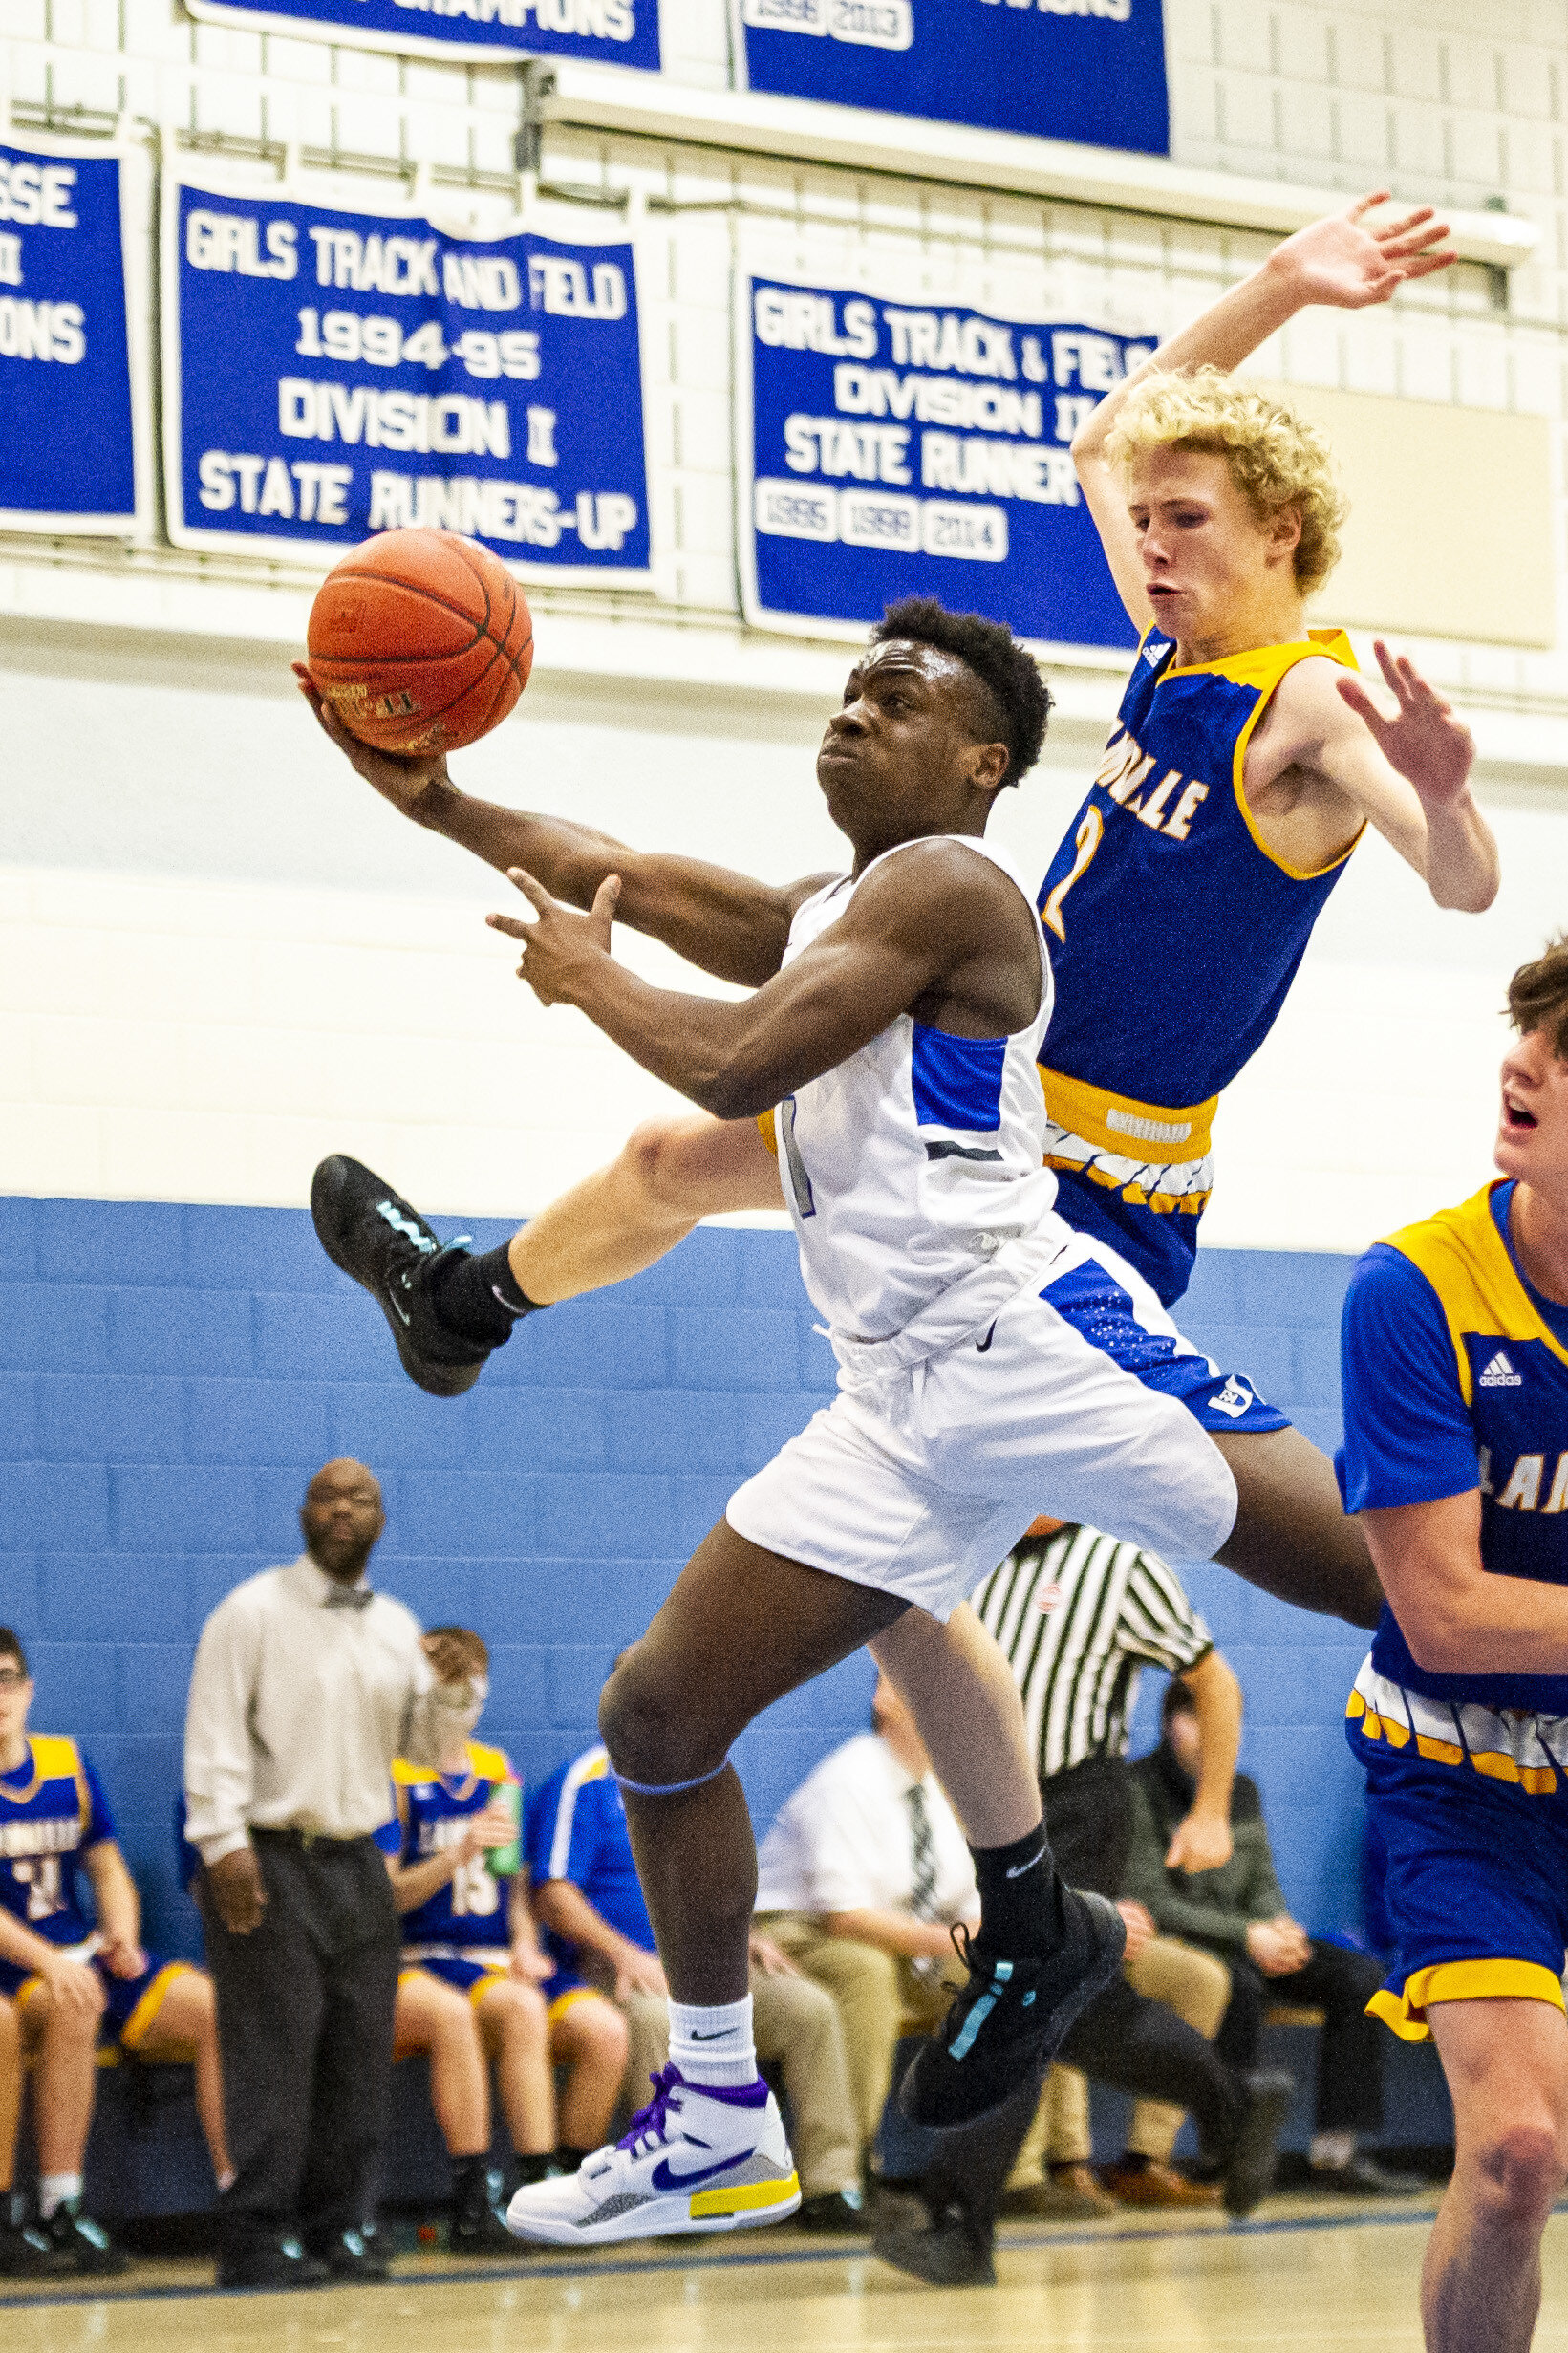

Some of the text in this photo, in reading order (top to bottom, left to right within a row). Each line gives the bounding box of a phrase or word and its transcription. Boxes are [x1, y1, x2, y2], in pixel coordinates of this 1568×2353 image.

[394, 0, 636, 42] PIONS
[187, 209, 628, 321] GIRLS TRACK AND FIELD
[295, 307, 541, 380] 1994-95
[755, 288, 878, 359] GIRLS
[882, 306, 1019, 382] TRACK
[1021, 336, 1047, 382] &
[279, 376, 510, 459] DIVISION
[834, 362, 1042, 438] DIVISION
[784, 414, 911, 486] STATE
[199, 449, 637, 550] STATE RUNNERS-UP
[1042, 805, 1105, 944] 2
[1479, 1374, 1522, 1387] adidas
